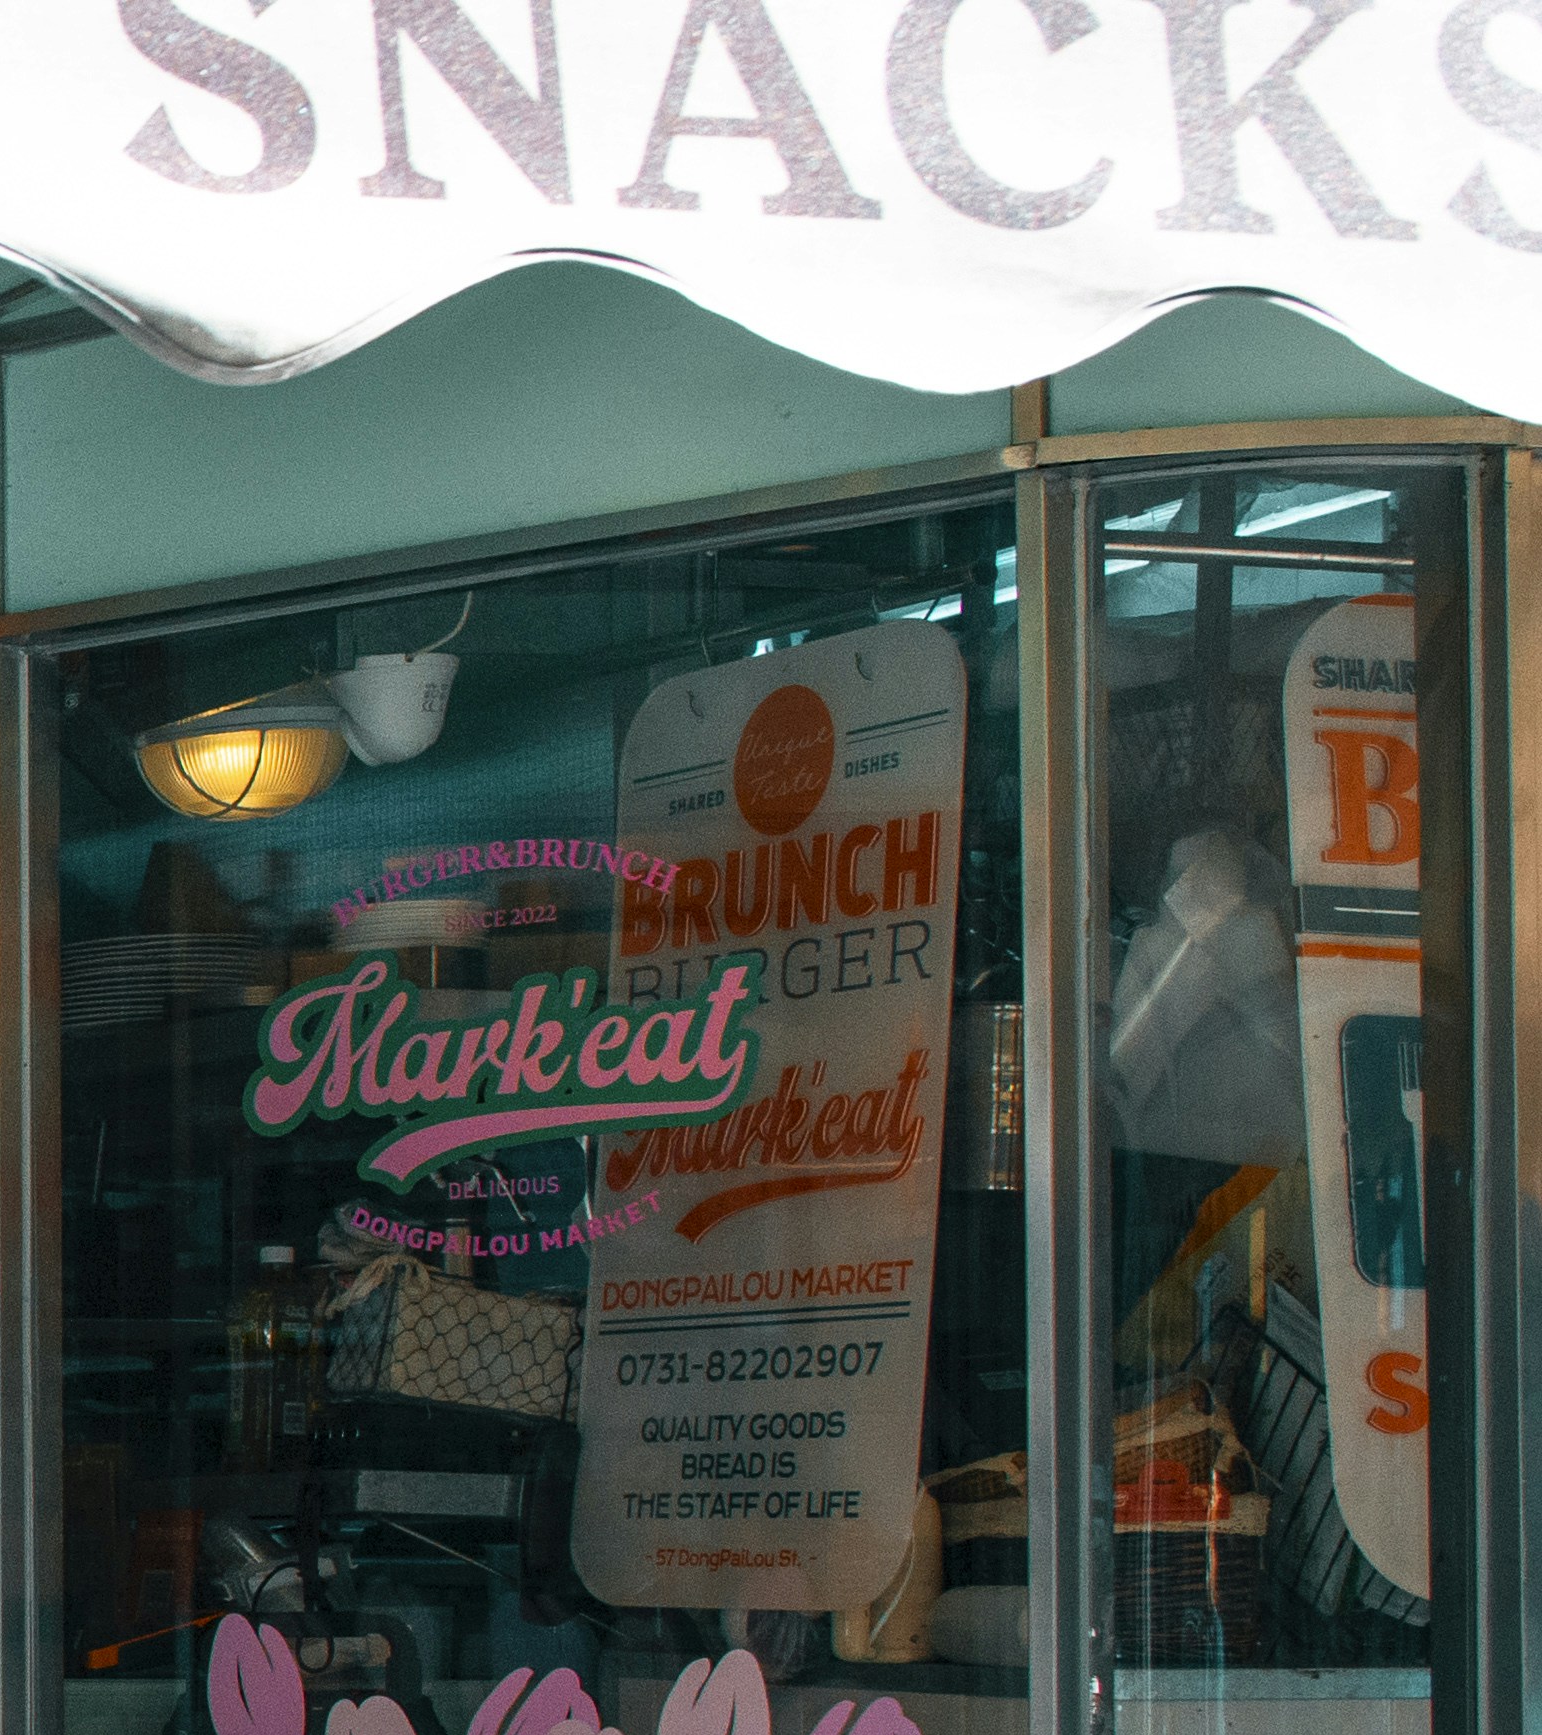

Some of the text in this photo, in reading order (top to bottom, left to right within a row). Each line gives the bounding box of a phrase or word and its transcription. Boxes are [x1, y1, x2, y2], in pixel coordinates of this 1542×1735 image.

[844, 752, 900, 779] DISHES
[668, 790, 725, 816] SHARED
[620, 811, 941, 958] BRUNCH
[511, 905, 557, 926] 2022
[250, 960, 751, 1124] Mark'eat
[447, 1175, 560, 1200] DELICIOUS
[349, 1189, 664, 1257] DONGPAILOU MARKET
[602, 1259, 915, 1312] DONGPAILOU MARKET
[617, 1343, 884, 1387] 0731-82202907
[640, 1410, 847, 1444] QUALITY GOODS
[680, 1451, 797, 1481] BREAD IS
[622, 1490, 861, 1520] THE STAFF OF LIFE
[655, 1549, 676, 1567] 57
